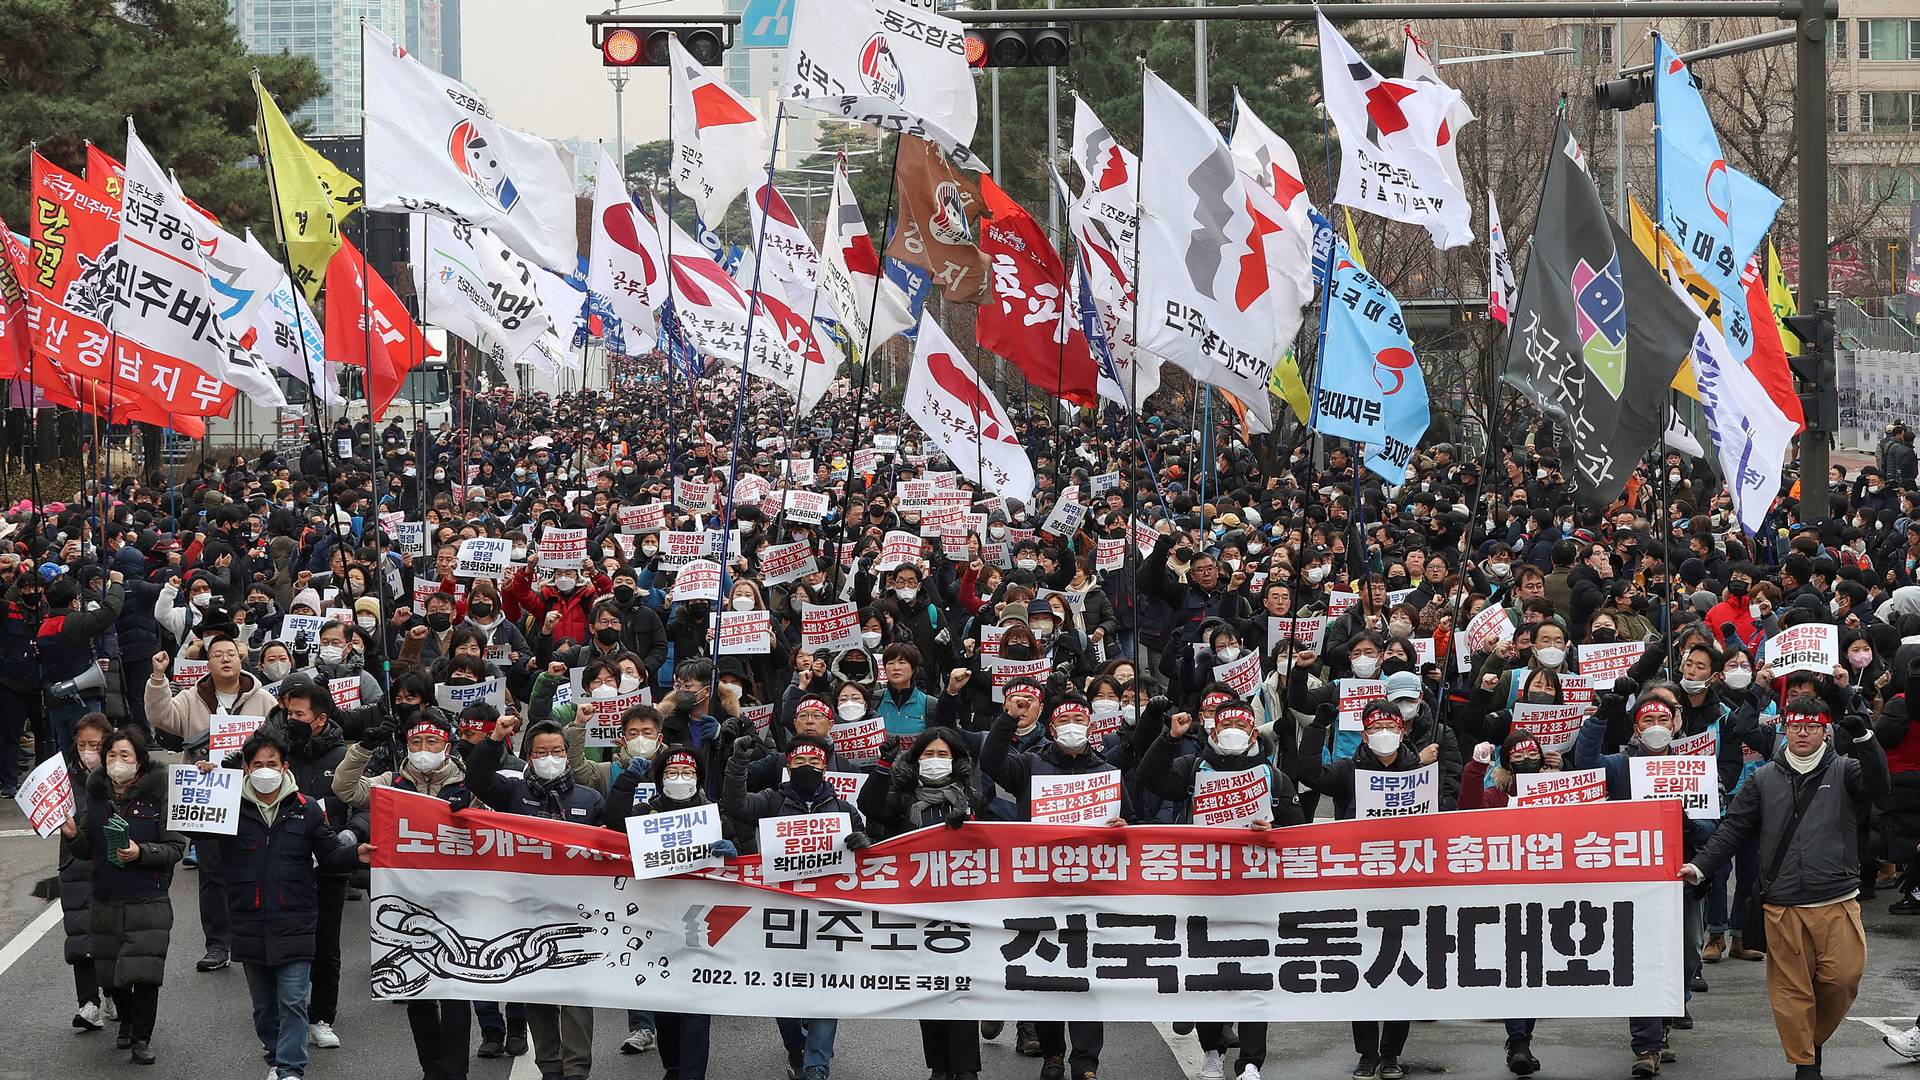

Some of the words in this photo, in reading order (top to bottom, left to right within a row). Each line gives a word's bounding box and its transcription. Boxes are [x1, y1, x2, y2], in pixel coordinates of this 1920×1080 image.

[128, 179, 166, 206] 민주노총
[679, 483, 709, 494] 화물안전
[904, 482, 930, 491] 화물안전
[788, 510, 821, 520] 확대하라!
[467, 541, 505, 552] 업무개시
[668, 533, 705, 544] 화물안전
[473, 550, 493, 561] 명령
[671, 545, 700, 555] 운임제
[460, 560, 502, 573] 철회하라!
[746, 612, 762, 621] 저지!
[805, 609, 829, 620] 노동개악
[830, 604, 849, 617] 저지!
[721, 637, 743, 646] 민영화
[745, 635, 761, 643] 중단!
[808, 634, 831, 644] 민영화
[832, 628, 850, 641] 중단!
[1776, 626, 1827, 646] 화물안전
[1586, 649, 1618, 660] 노동개악
[1619, 644, 1637, 653] 저지!
[1780, 639, 1821, 655] 운임제
[997, 664, 1025, 674] 노동개악
[1027, 660, 1044, 672] 저지!
[1582, 661, 1605, 672] 노조법
[1772, 652, 1828, 668] 확대하라!
[1565, 679, 1586, 688] 저지!
[1592, 670, 1616, 681] 민영화
[339, 680, 354, 689] 저지!
[451, 682, 497, 700] 업무개시
[1348, 685, 1382, 696] 노동개악
[590, 694, 642, 713] 화물안전
[1571, 690, 1591, 701] 개정!
[749, 706, 766, 718] 저지!
[1343, 698, 1367, 710] 노조법
[1522, 711, 1558, 721] 노동개악
[1559, 707, 1578, 716] 저지!
[218, 723, 256, 733] 노동개악
[859, 721, 878, 735] 저지!
[1515, 723, 1541, 734] 노조법
[1563, 718, 1580, 729] 개정!
[214, 736, 240, 747] 노조법
[1552, 733, 1571, 744] 중단!
[1690, 733, 1710, 749] 저지!
[1645, 760, 1706, 777] 화물안전
[175, 770, 231, 790] 업무개시
[1041, 781, 1085, 797] 노동개악
[1087, 774, 1111, 788] 저지!
[1200, 778, 1230, 795] 노동개악
[1232, 772, 1256, 787] 저지!
[1370, 773, 1429, 792] 업무개시
[1526, 778, 1571, 796] 노동개악
[1572, 771, 1597, 786] 저지!
[1653, 776, 1698, 793] 운임제
[181, 786, 211, 805] 명령
[1036, 798, 1067, 812] 노조법
[1096, 787, 1118, 801] 개정!
[1196, 797, 1218, 812] 노조법
[1244, 783, 1267, 800] 개정!
[1384, 791, 1415, 807] 명령
[1581, 785, 1604, 798] 개정!
[171, 804, 227, 824] 철회하라!
[1083, 807, 1108, 819] 중단!
[1205, 810, 1235, 826] 민영화
[1236, 803, 1260, 819] 중단!
[643, 810, 708, 835] 업무개시
[776, 818, 841, 839] 화물안전
[661, 830, 693, 849] 명령
[784, 836, 833, 854] 운임제
[397, 818, 553, 860] 노동개악
[909, 847, 1000, 888] 개정!
[1011, 843, 1130, 883] 민영화
[1140, 844, 1231, 882] 중단!
[1241, 837, 1437, 880] 화물노동자
[1446, 832, 1564, 874] 총파업
[1574, 830, 1665, 868] 승리!
[643, 844, 711, 869] 철회하라!
[773, 852, 842, 873] 확대하라!
[762, 906, 971, 953] 민주노총
[1000, 900, 1635, 994] 전국노동자대회
[692, 969, 738, 985] 2022.
[743, 970, 766, 986] 12.
[771, 970, 815, 989] 3(토)
[820, 973, 855, 989] 14시
[859, 974, 911, 991] 여의도
[915, 975, 950, 991] 국회
[954, 975, 972, 992] 앞
